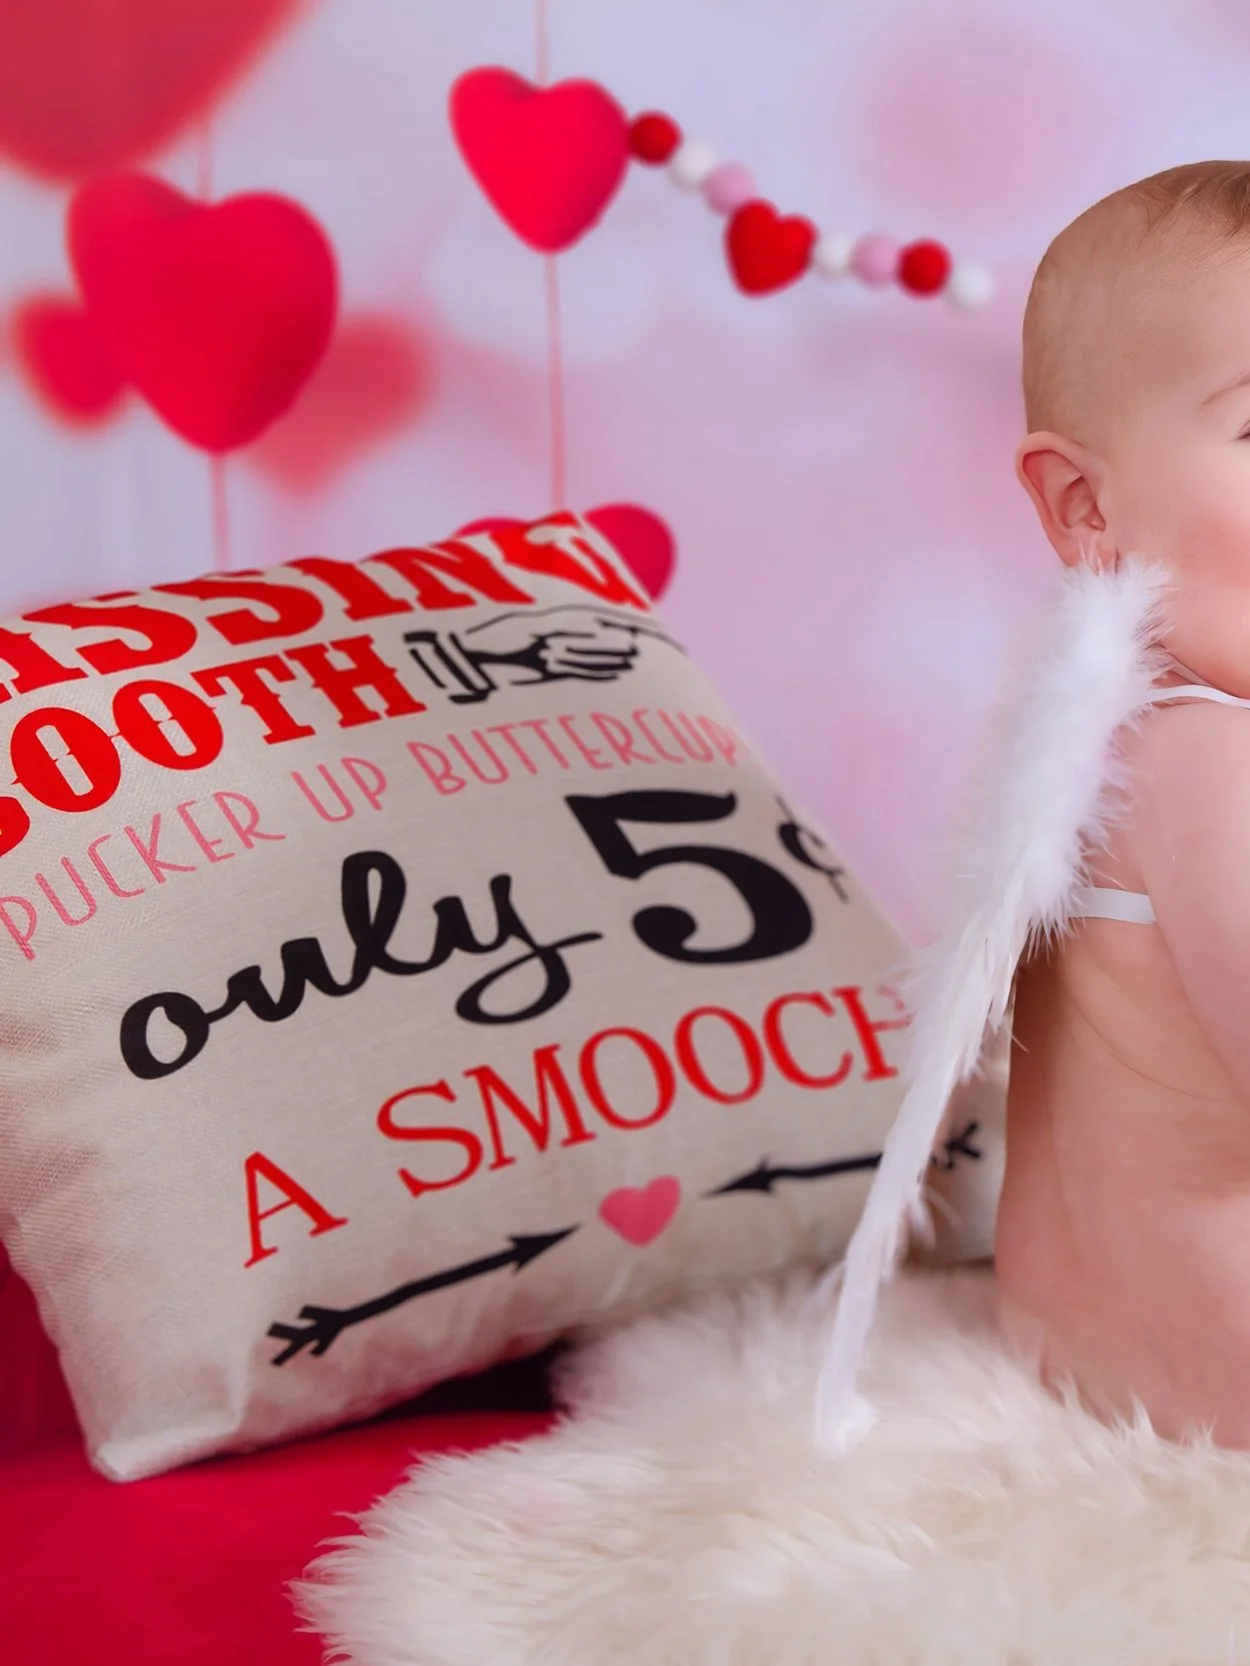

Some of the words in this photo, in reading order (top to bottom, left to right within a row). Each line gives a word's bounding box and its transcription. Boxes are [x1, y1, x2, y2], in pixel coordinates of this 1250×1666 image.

[0, 791, 286, 962] PUCKER
[291, 757, 387, 823] UP
[406, 708, 736, 797] BUTTERCUP
[119, 850, 603, 1080] only
[243, 1150, 350, 1270] A
